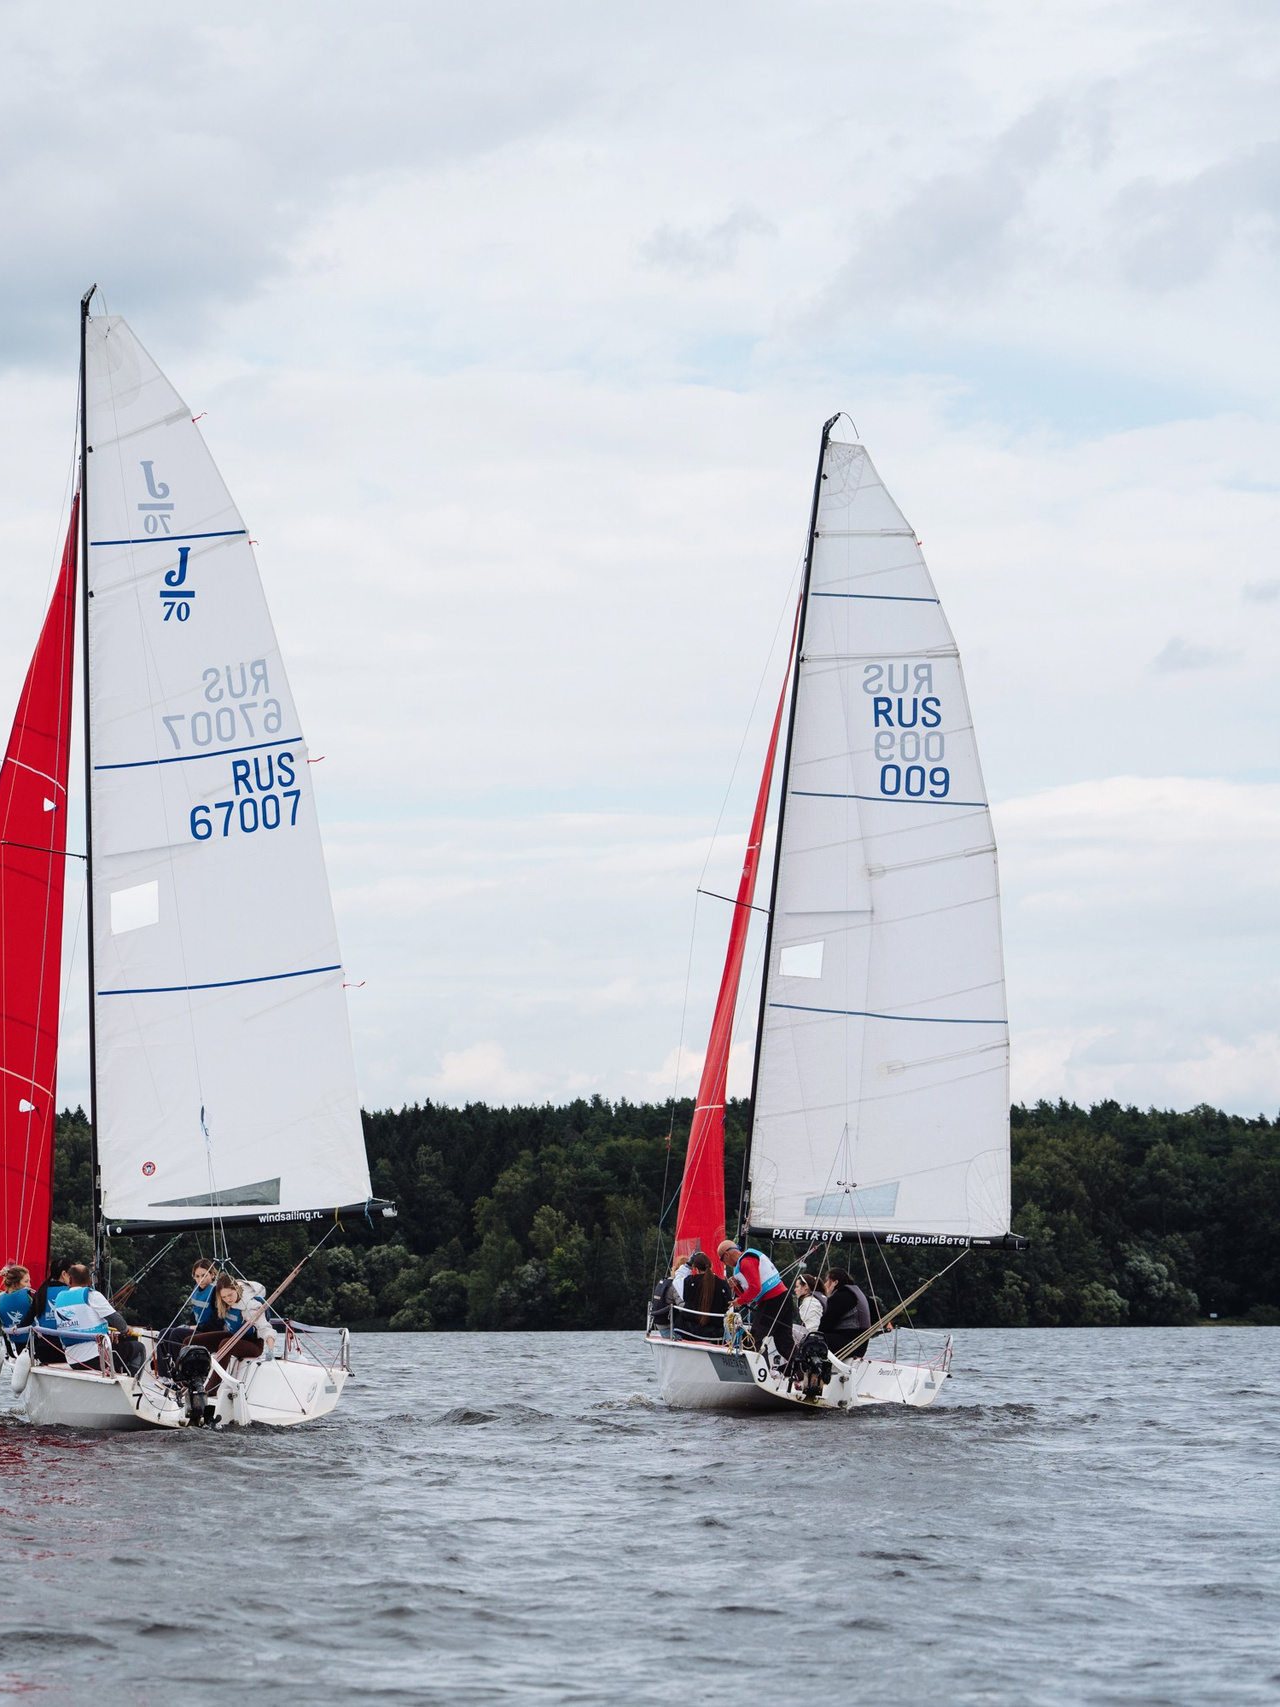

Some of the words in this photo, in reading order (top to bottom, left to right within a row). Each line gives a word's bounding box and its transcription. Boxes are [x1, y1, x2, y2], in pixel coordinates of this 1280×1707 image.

[164, 547, 191, 587] J
[163, 602, 190, 622] 70
[873, 697, 942, 728] RUS
[231, 752, 295, 796] RUS
[880, 764, 950, 798] 009
[190, 789, 301, 840] 67007
[757, 1368, 767, 1382] 9
[132, 1393, 143, 1410] 7
